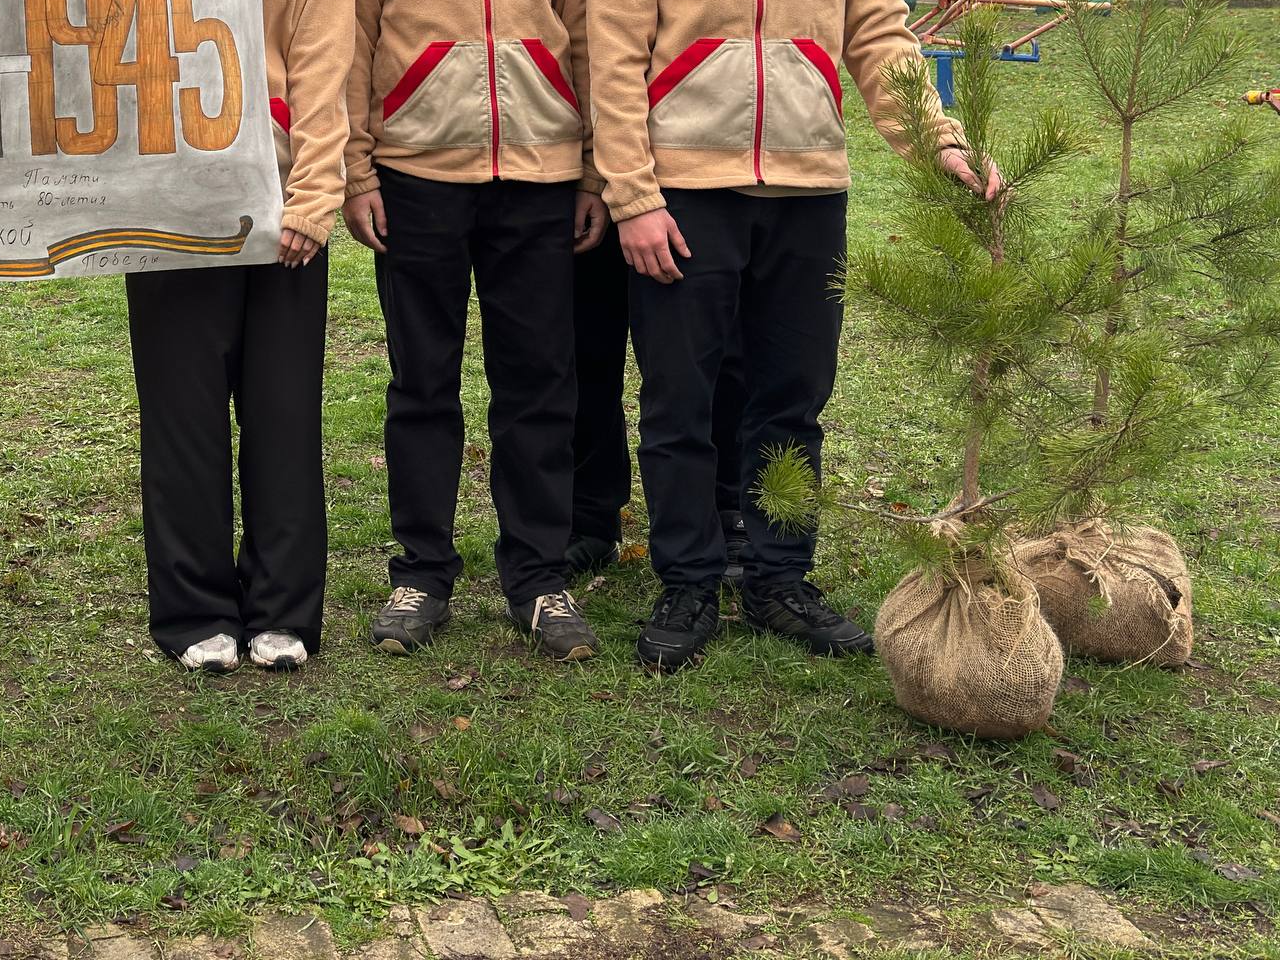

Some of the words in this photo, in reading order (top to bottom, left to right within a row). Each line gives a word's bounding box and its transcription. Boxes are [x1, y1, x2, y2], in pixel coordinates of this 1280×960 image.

[23, 167, 99, 189] Памяти
[37, 191, 107, 207] 80-летия
[82, 252, 160, 272] Победы
